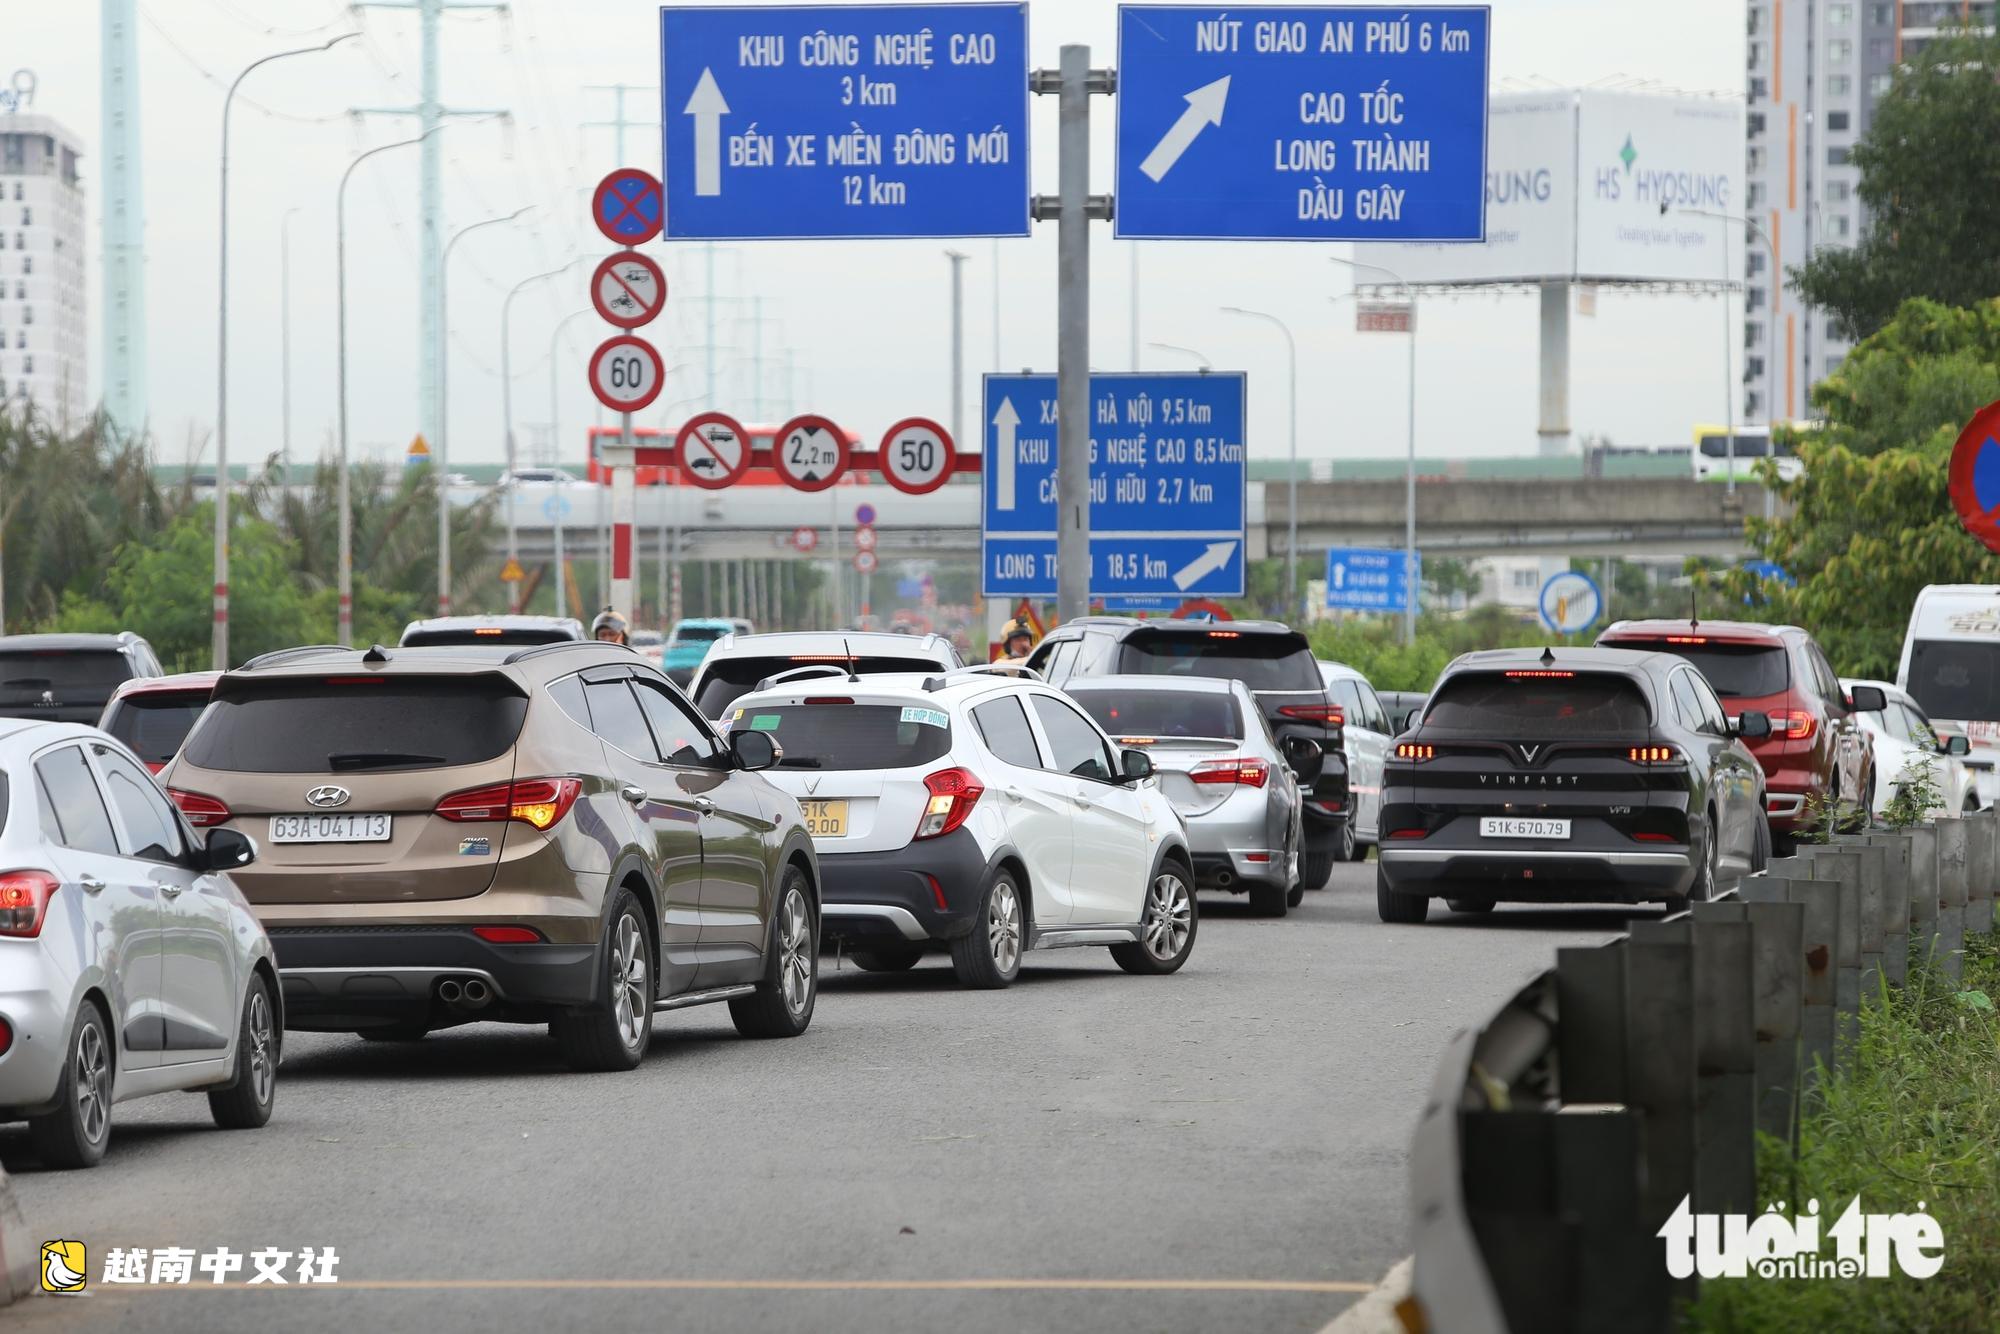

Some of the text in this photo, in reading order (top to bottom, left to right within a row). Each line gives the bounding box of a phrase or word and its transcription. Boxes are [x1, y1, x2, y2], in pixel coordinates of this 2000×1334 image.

[740, 28, 995, 69] KHU CÔNG NGHỆ CAO
[1197, 14, 1469, 52] NÚT GIAO AN PHÚ 6 km
[842, 75, 896, 105] 3 km
[1301, 80, 1403, 123] CAO TỐC
[730, 122, 1008, 166] BẾN XE MIỀN ĐÔNG MỚI
[1276, 133, 1429, 171] LONG THÀNH
[844, 175, 905, 204] 12 km
[1299, 176, 1404, 220] DẦU GIÂY
[1597, 167, 1729, 207] HS HYOSUNG
[611, 357, 642, 388] 60
[1099, 394, 1117, 422] HÀ
[1129, 393, 1151, 426] NỘI
[1163, 399, 1183, 423] 9,5
[1189, 400, 1210, 422] km
[823, 452, 835, 465] m
[901, 440, 933, 471] 50
[1020, 440, 1048, 463] KHU
[1108, 434, 1146, 466] NGHỆ
[1157, 439, 1185, 462] CAO
[1196, 439, 1215, 462] 8,5
[1220, 439, 1242, 463] km
[1040, 469, 1212, 504] CẦ HÚ HỮU 2,7 km
[996, 555, 1034, 578] LONG
[1109, 555, 1137, 579] 18,5
[1145, 555, 1166, 577] km
[903, 709, 912, 720] XE
[1480, 775, 1577, 784] VINFAST
[801, 803, 829, 817] 51K
[274, 816, 386, 839] 63A-041.13
[1488, 822, 1563, 835] 51K-670.79
